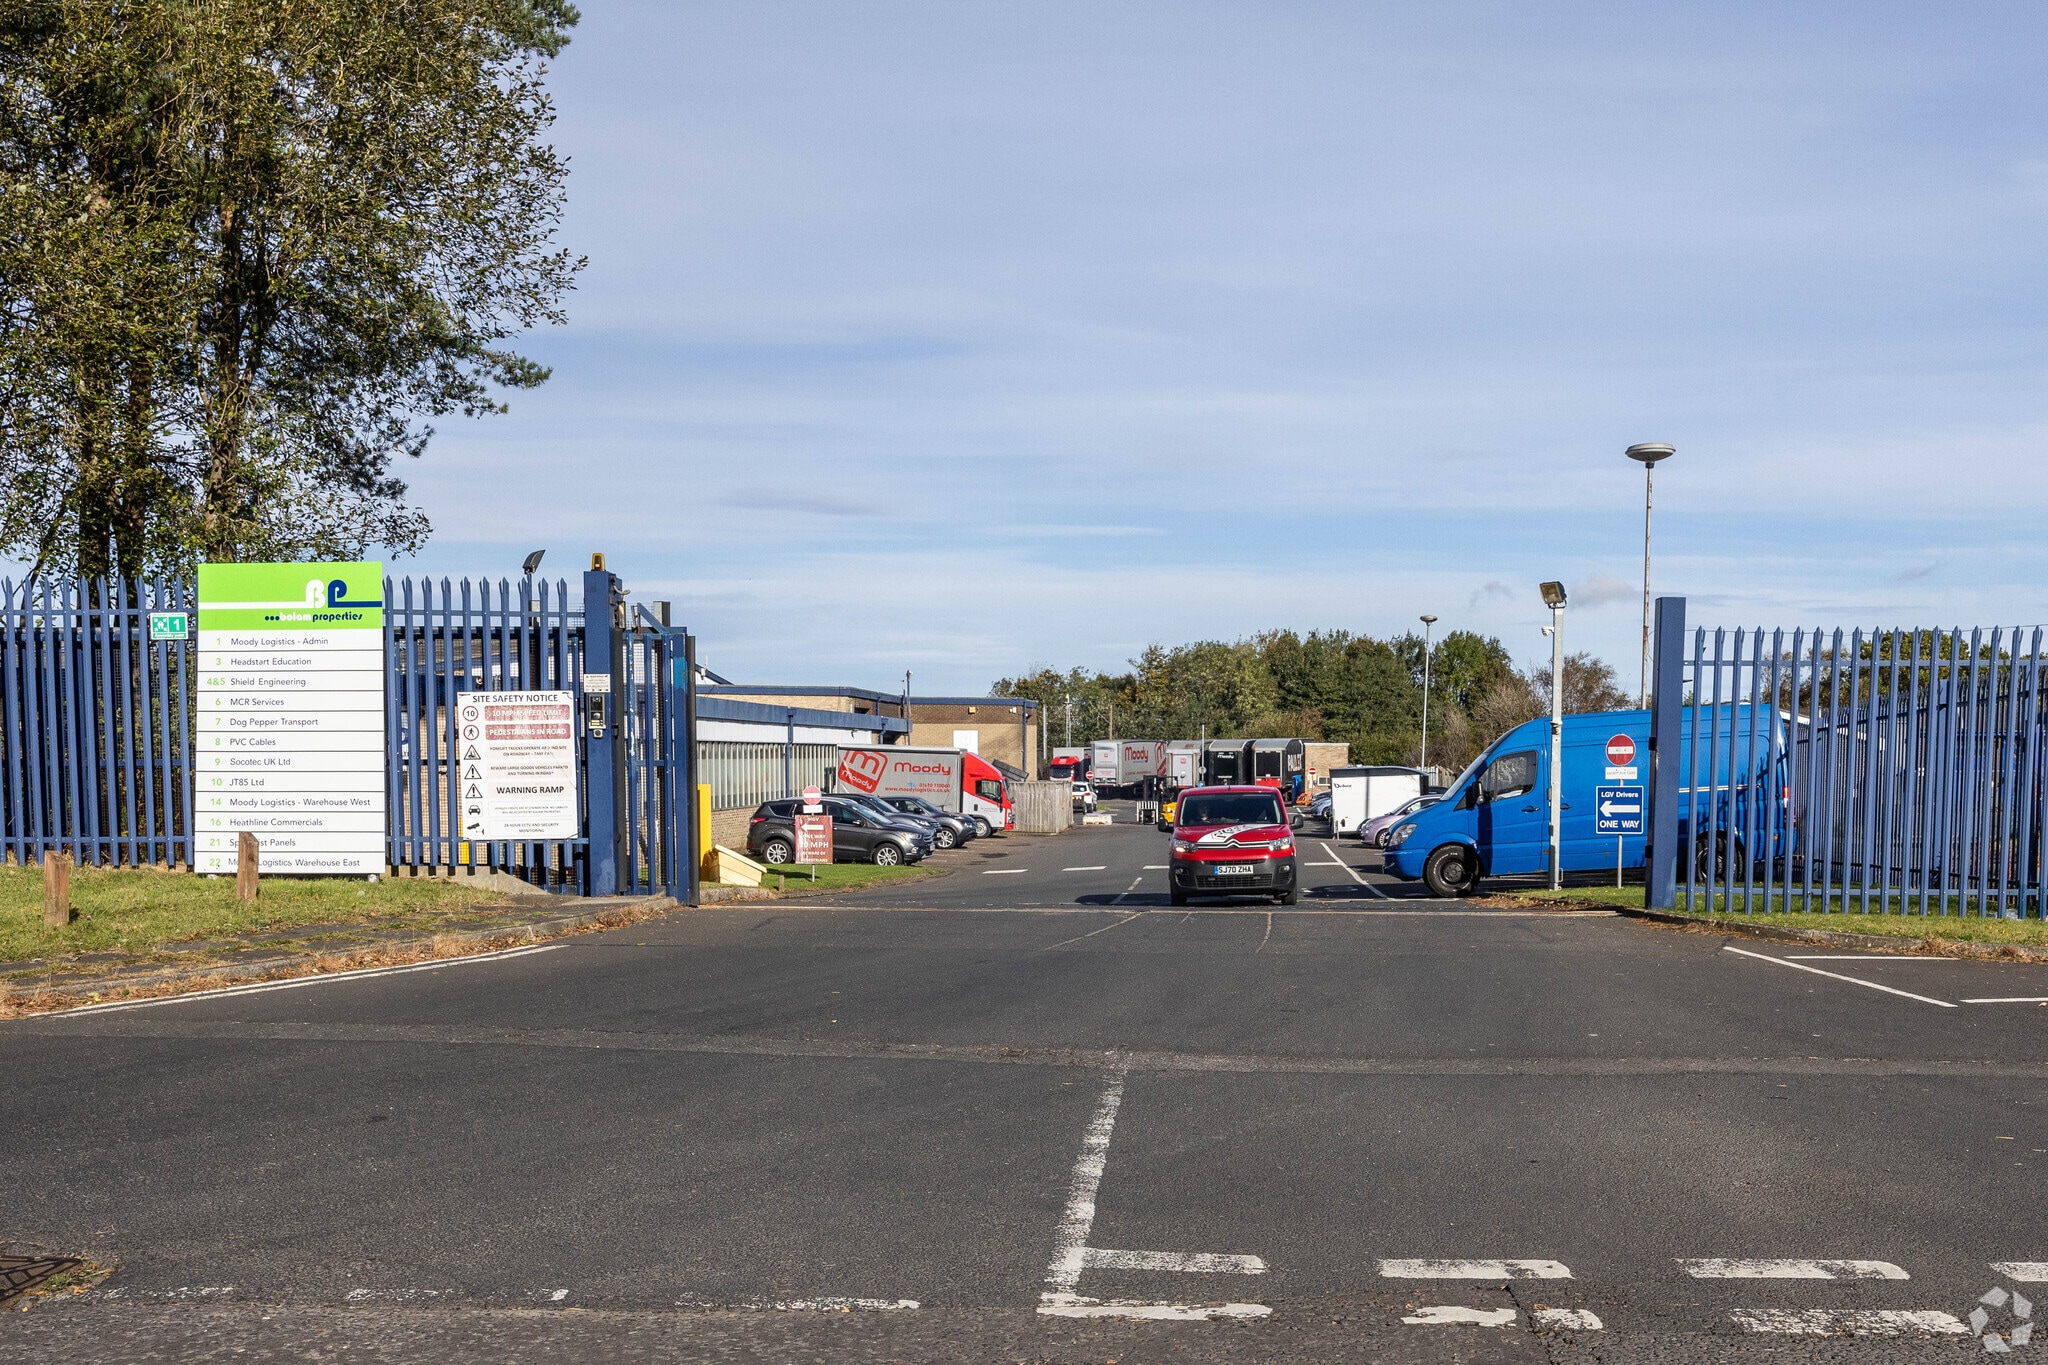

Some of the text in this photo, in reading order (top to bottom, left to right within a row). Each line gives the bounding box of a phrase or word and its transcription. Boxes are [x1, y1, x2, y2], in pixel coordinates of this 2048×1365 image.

[173, 619, 180, 631] 1
[216, 638, 221, 646] 1
[231, 638, 258, 648] Moody
[261, 638, 295, 648] Logistics
[302, 637, 329, 645] Admin
[215, 657, 312, 666] 3 Headstart Education
[206, 677, 306, 687] 4&5 Shield Engineering
[215, 698, 284, 706] 6 MCR Services
[472, 694, 558, 703] SITE SAFETY NOTICE
[215, 718, 319, 727] 7 Dog Pepper Transport
[214, 738, 276, 746] 8 PVC Cables
[1124, 746, 1149, 763] Moody
[214, 758, 291, 766] 9 Socotec UK Ltd
[893, 761, 952, 776] Moody
[210, 778, 265, 786] 10 JT85 Ltd
[841, 769, 873, 791] Moody
[496, 786, 565, 794] WARNING RAMP
[210, 798, 222, 806] 14
[229, 798, 258, 808] Moody
[261, 798, 296, 808] Logistics
[302, 798, 348, 806] Warehouse
[350, 798, 371, 806] West
[210, 818, 323, 826] 16 Heathline Commercials
[1599, 820, 1640, 828] ONE WAY
[209, 838, 221, 846] 21
[270, 838, 296, 846] Panels
[209, 858, 221, 866] 22
[295, 858, 340, 866] Warehouse
[342, 858, 360, 866] East
[1218, 865, 1252, 873] SJ70 ZHA
